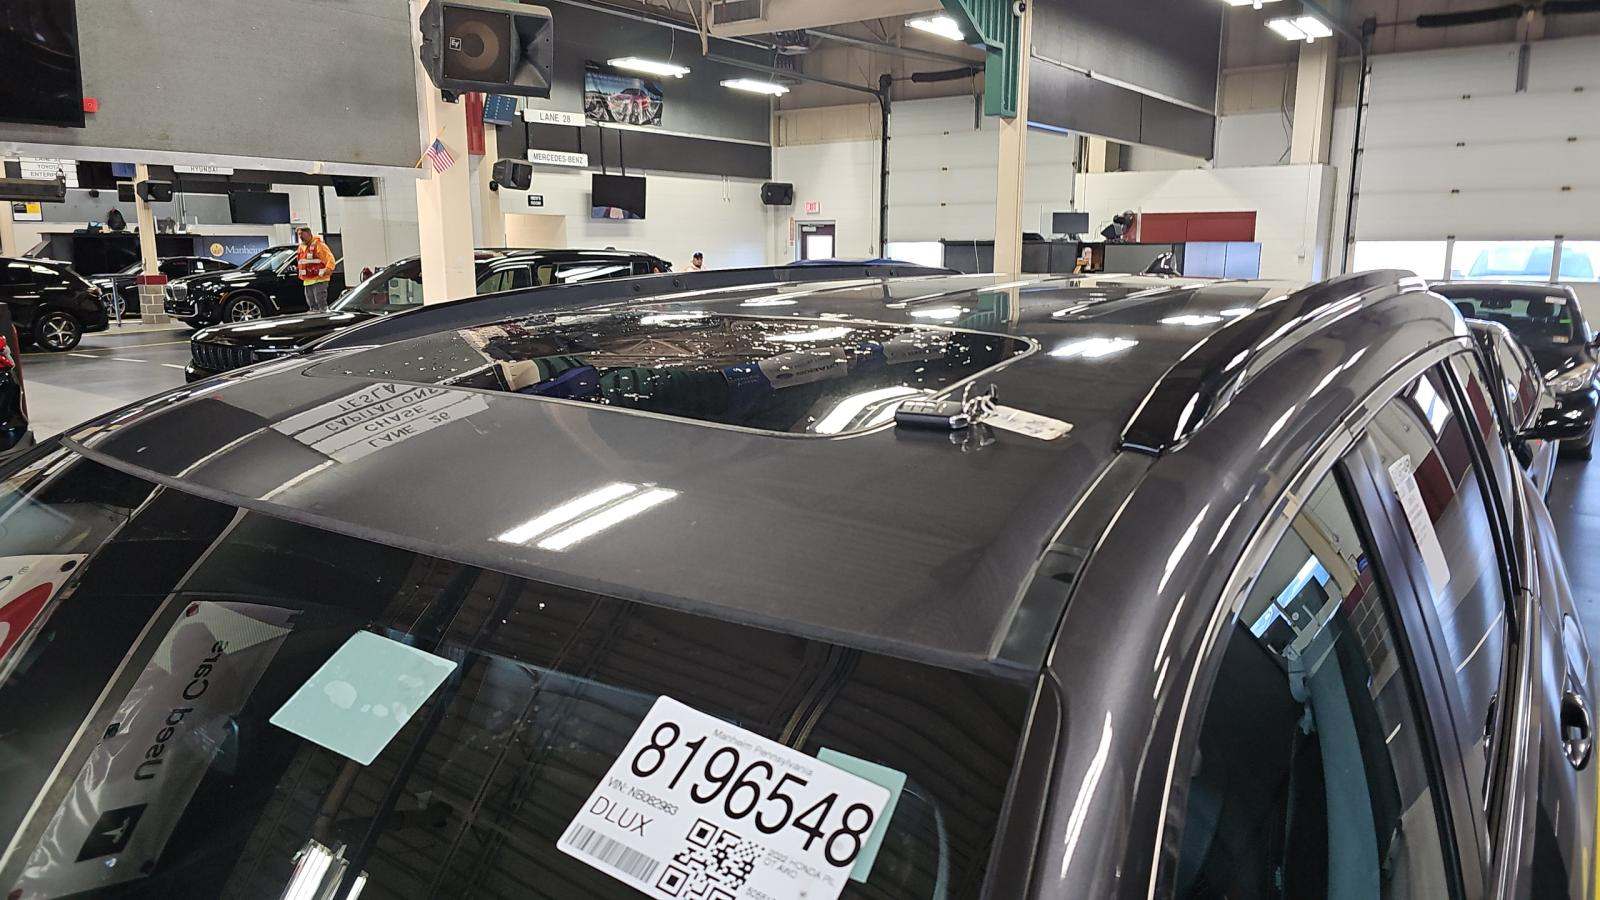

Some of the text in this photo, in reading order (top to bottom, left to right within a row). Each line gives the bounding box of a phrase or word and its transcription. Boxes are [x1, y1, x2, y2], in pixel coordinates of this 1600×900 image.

[539, 112, 571, 123] LANE 28
[714, 728, 753, 750] Manheim
[631, 722, 873, 867] 8196548
[590, 796, 653, 837] DLUX
